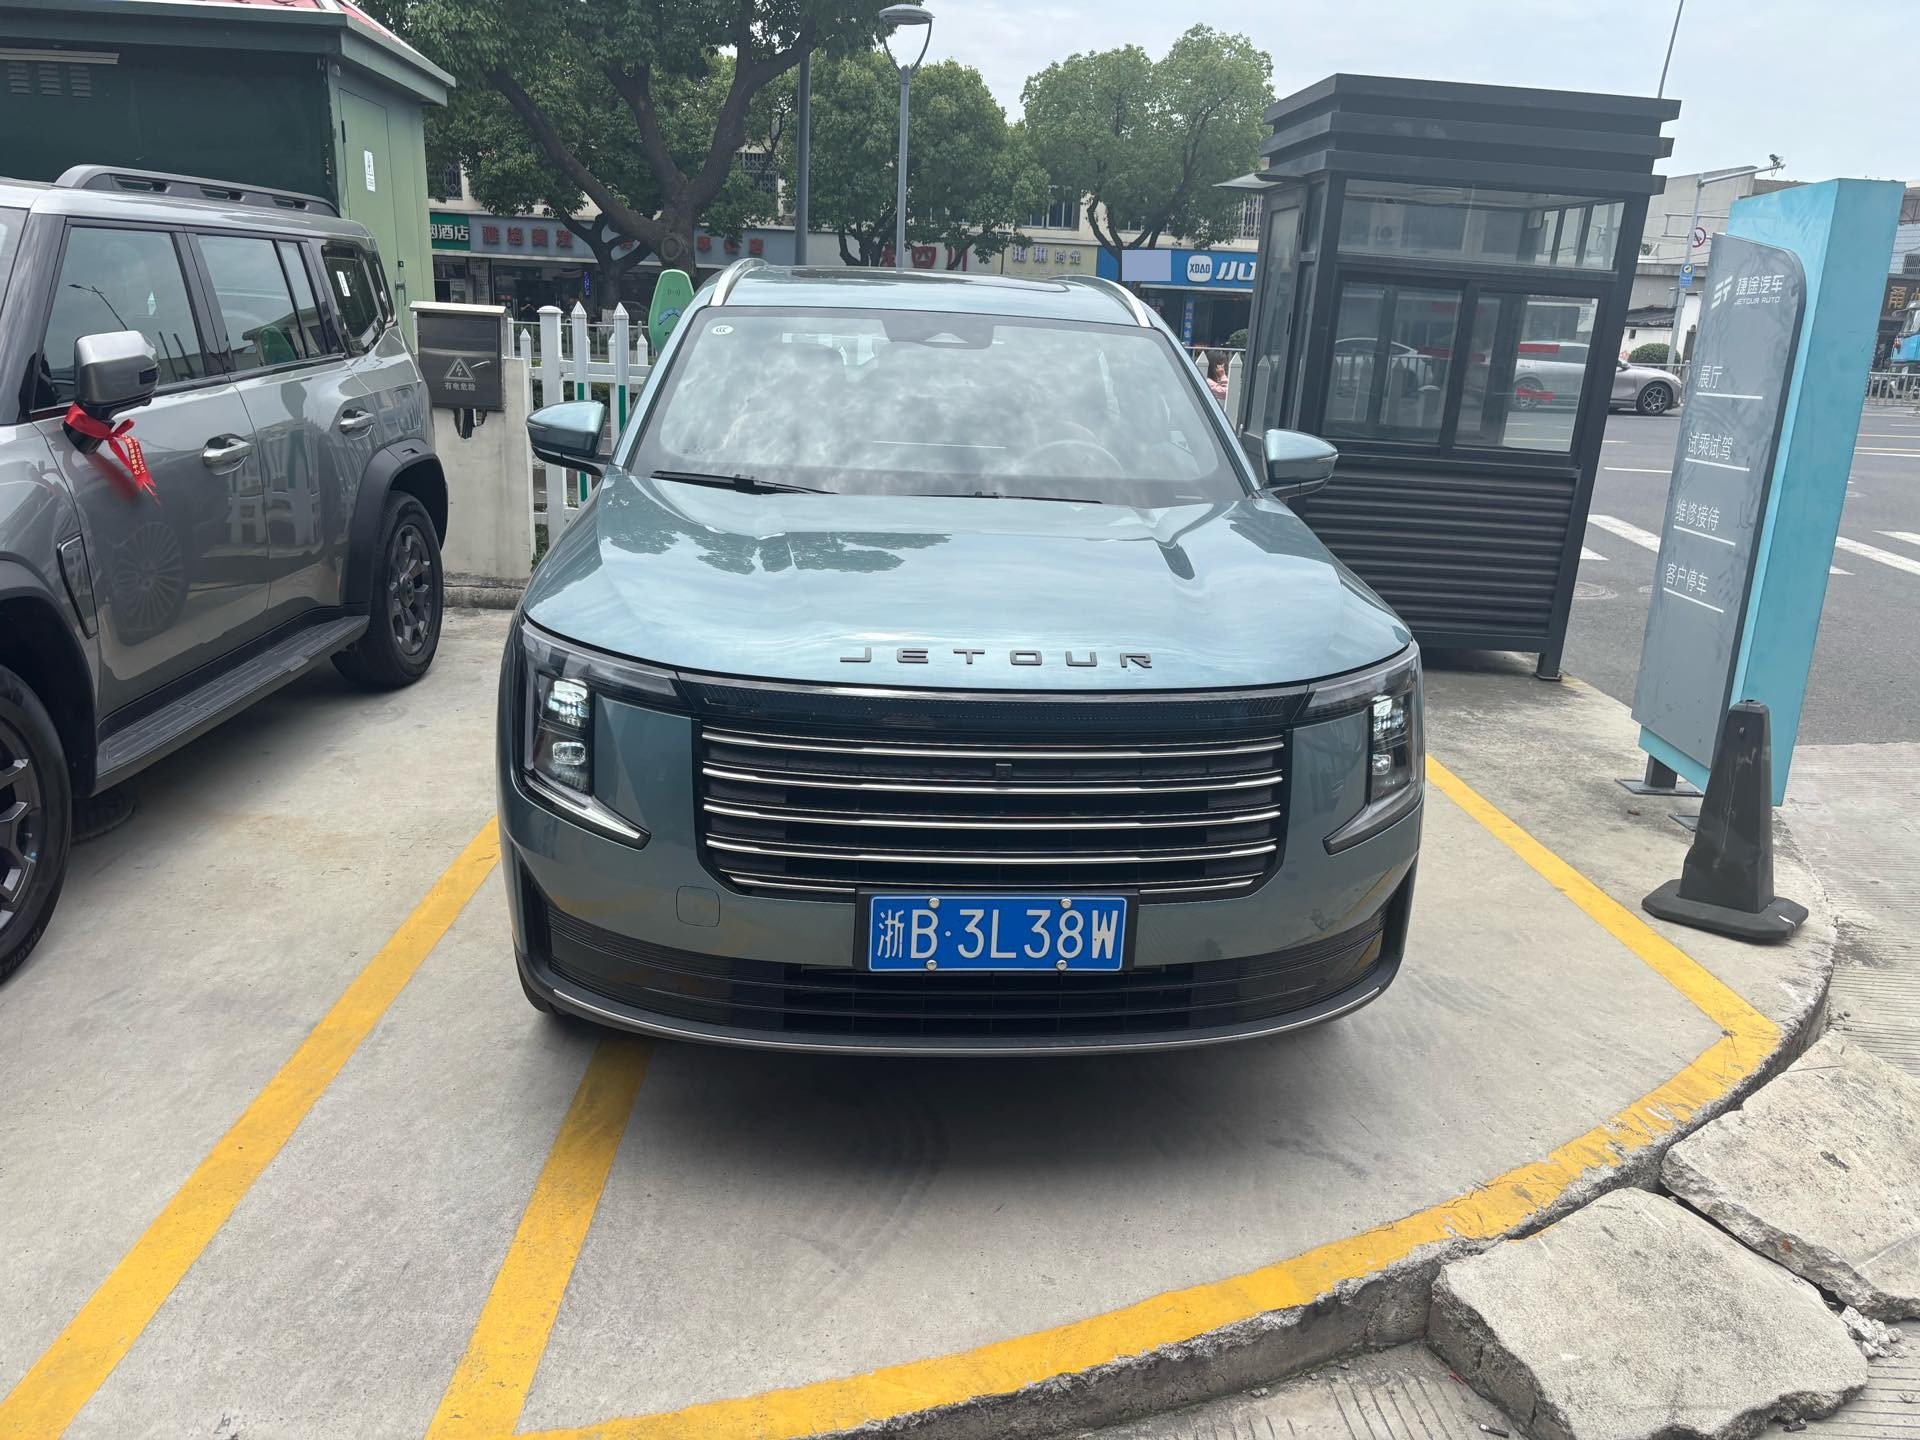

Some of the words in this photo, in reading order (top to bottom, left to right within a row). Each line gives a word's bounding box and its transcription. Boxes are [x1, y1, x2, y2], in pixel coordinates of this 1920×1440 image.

[1736, 275, 1785, 296] 捷途汽车
[1734, 297, 1760, 306] JETOUR
[1761, 296, 1781, 305] AUTO
[1697, 365, 1723, 389] 展厅
[1687, 431, 1734, 461] 试乘试驾
[1675, 499, 1721, 531] 维修接待
[1665, 562, 1709, 596] 客户停车
[840, 647, 1153, 669] JETOUR
